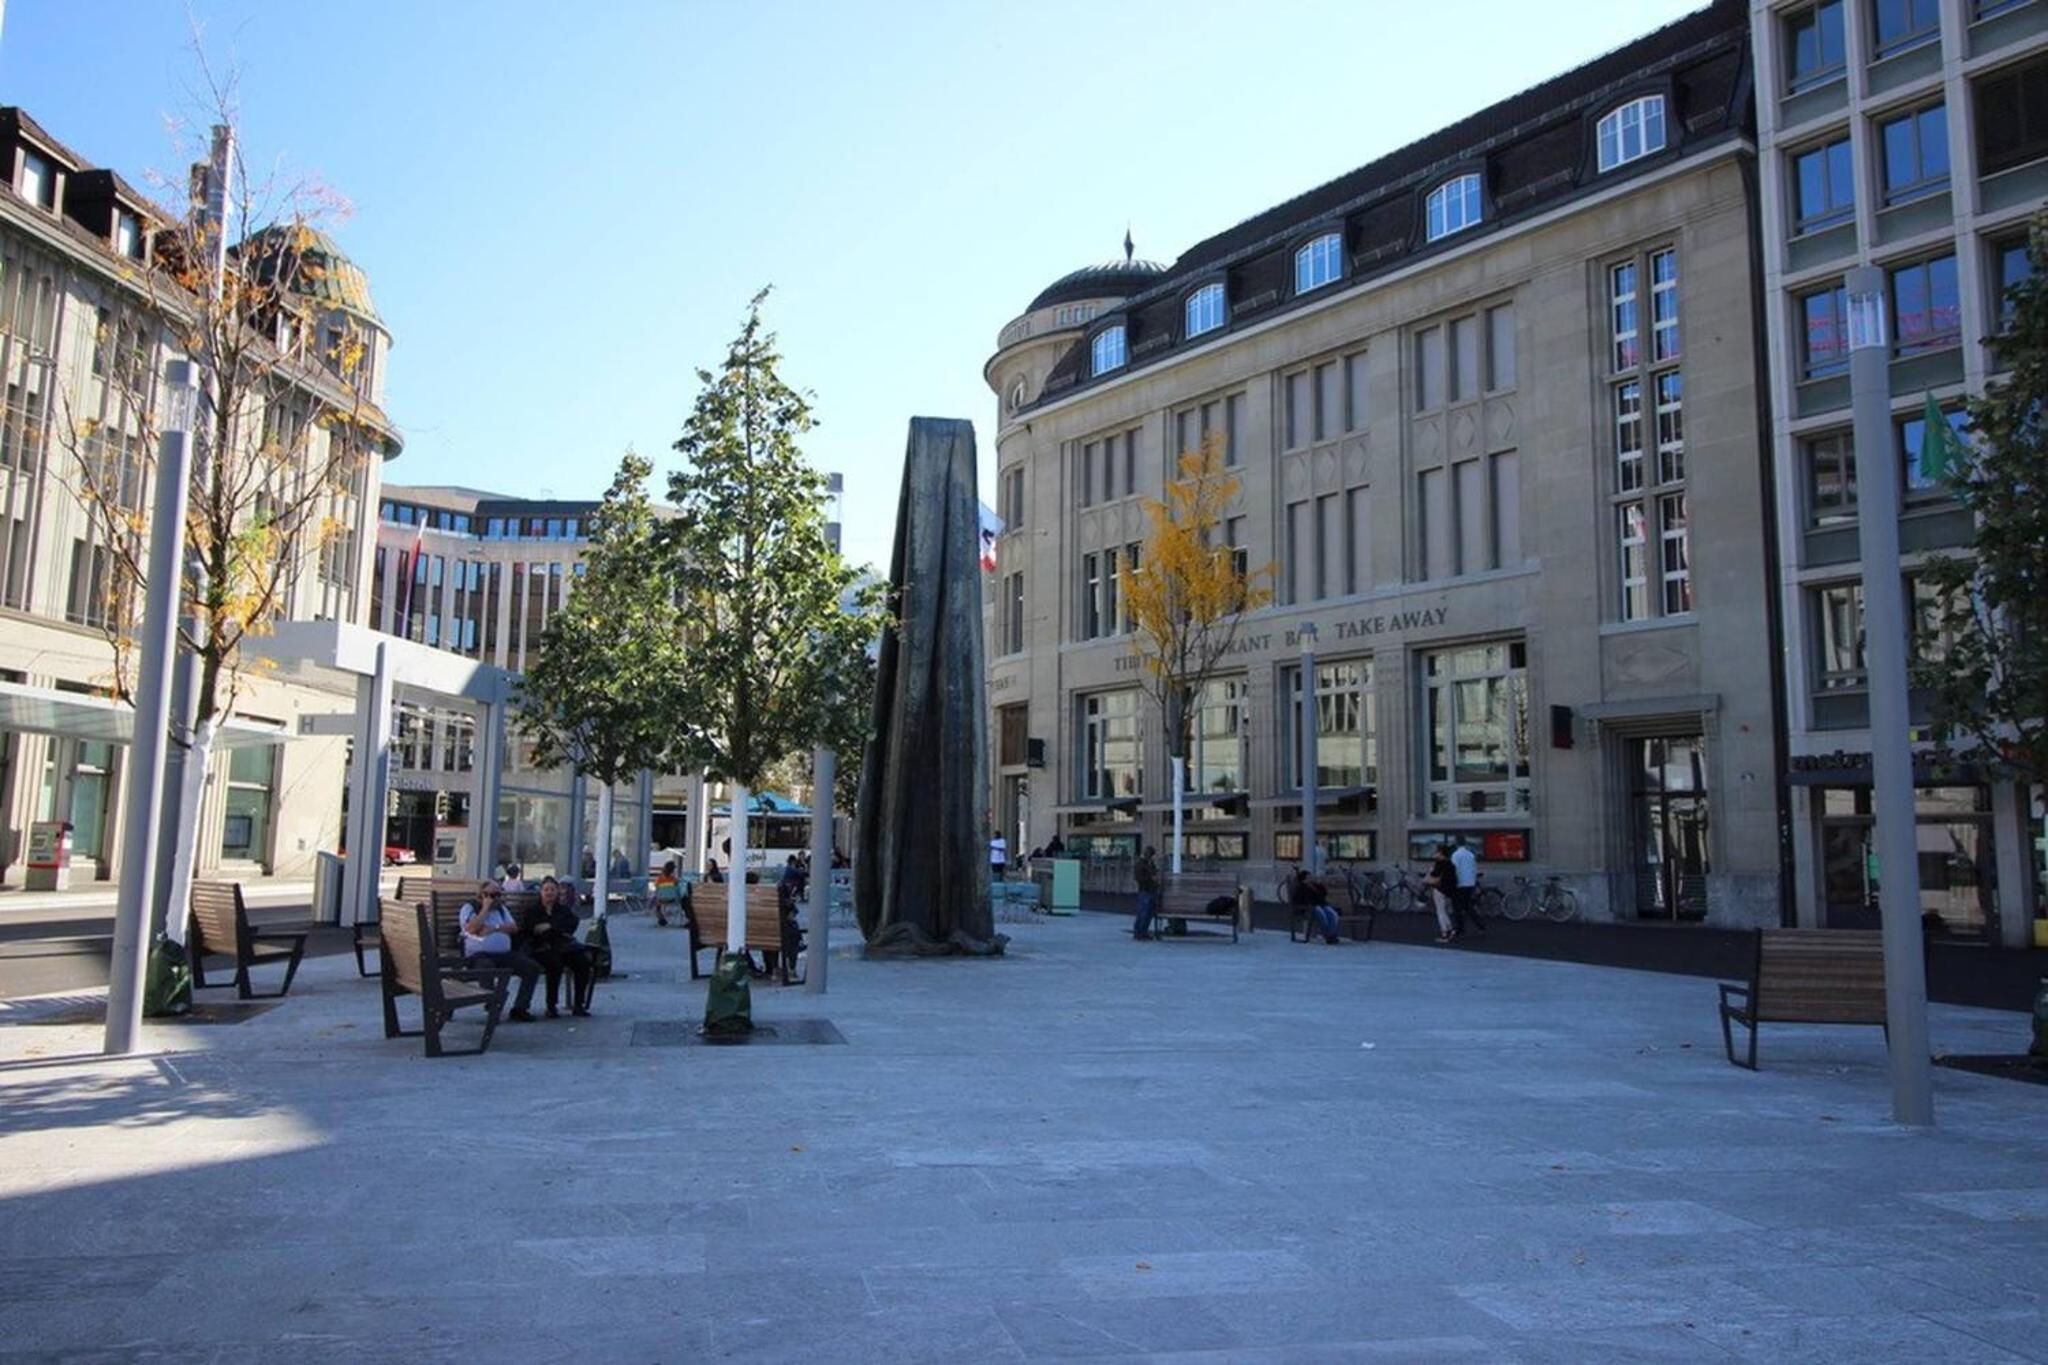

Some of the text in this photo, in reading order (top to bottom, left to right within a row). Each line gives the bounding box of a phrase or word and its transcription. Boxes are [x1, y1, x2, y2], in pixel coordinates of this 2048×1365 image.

[1169, 634, 1272, 663] STAURANT
[1335, 617, 1385, 640] TAKE
[1390, 606, 1449, 632] AWAY
